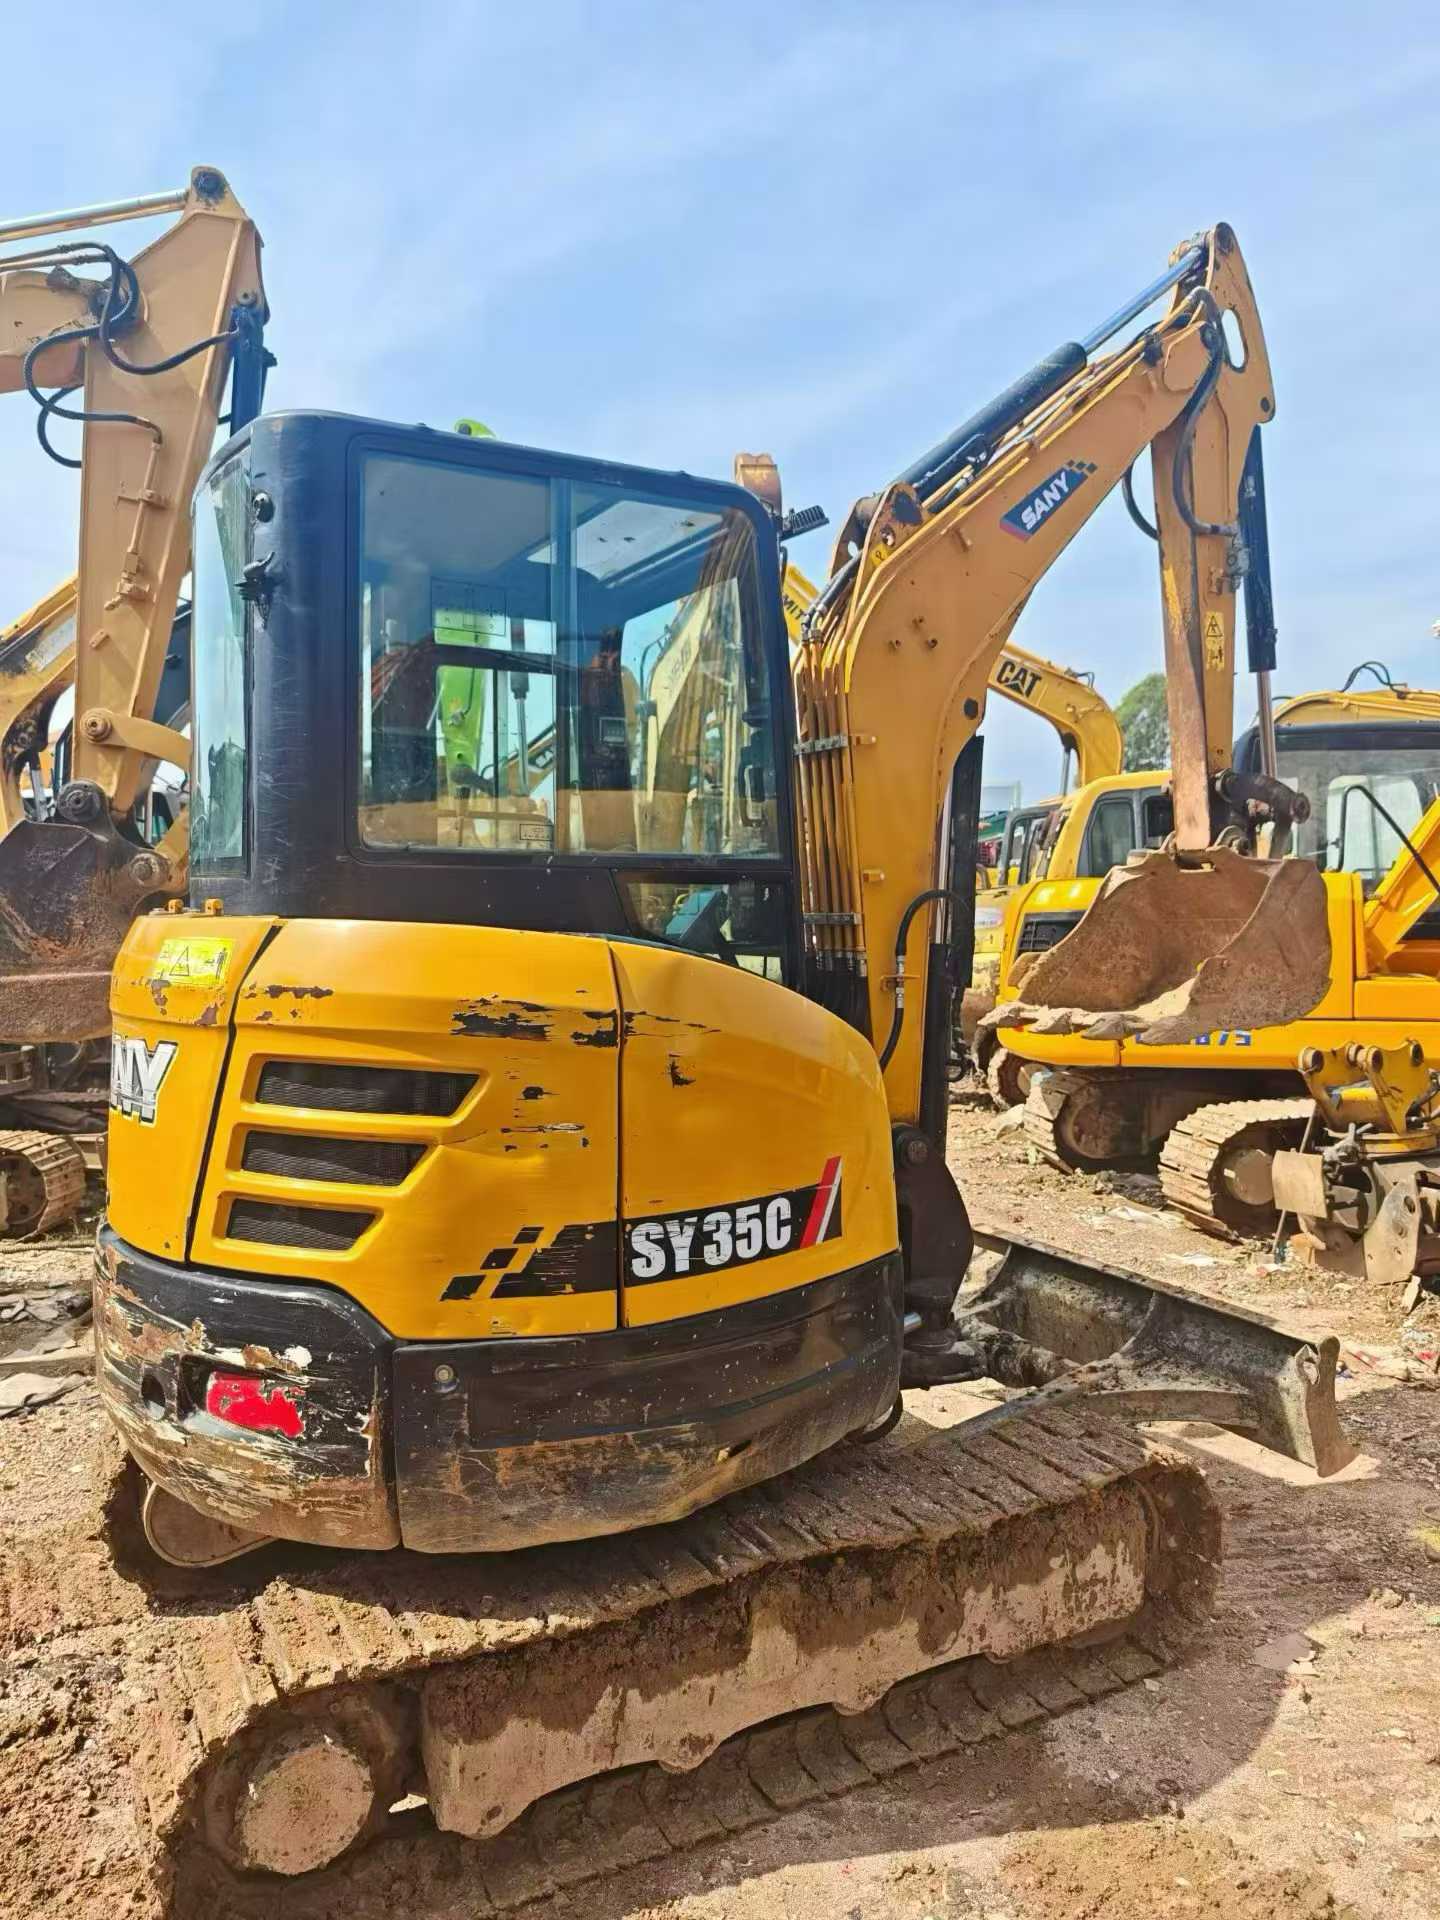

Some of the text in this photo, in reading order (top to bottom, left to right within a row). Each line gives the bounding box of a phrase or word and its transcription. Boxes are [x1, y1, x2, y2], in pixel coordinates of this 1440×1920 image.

[1021, 471, 1069, 531] SANY
[997, 660, 1042, 698] CAT
[631, 1197, 792, 1279] SY35C
